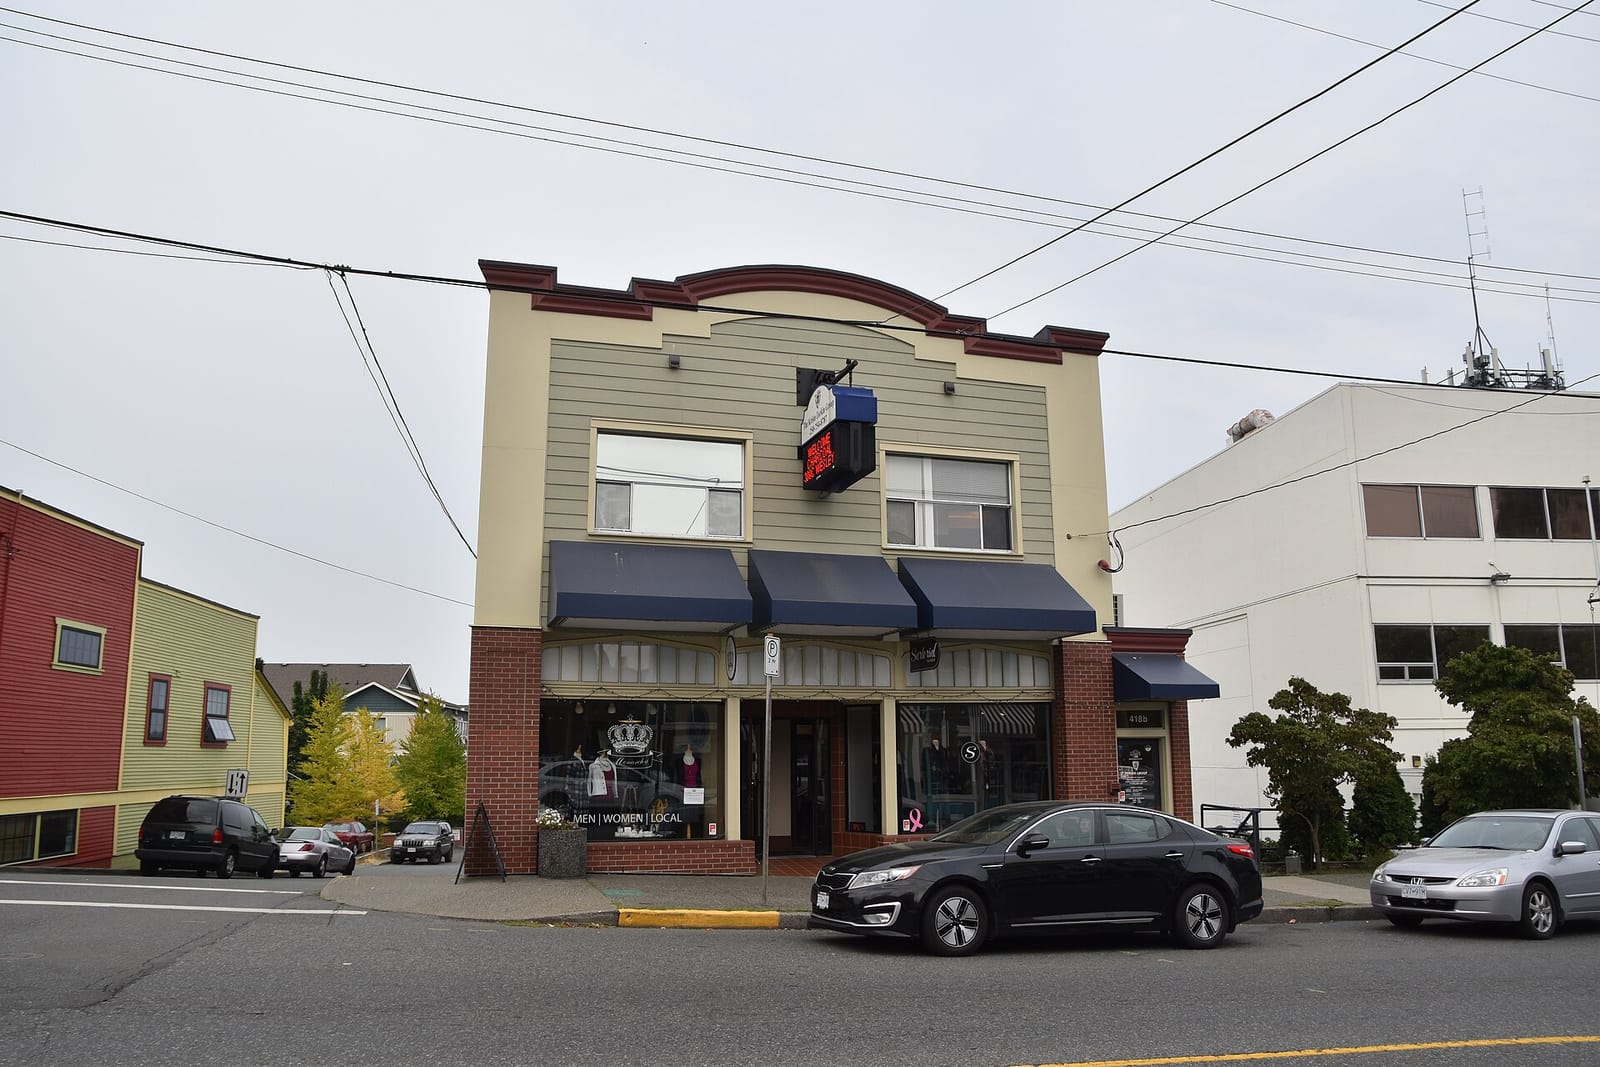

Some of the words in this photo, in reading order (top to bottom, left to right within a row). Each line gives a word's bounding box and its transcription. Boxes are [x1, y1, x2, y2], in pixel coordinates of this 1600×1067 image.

[1129, 714, 1148, 723] 418b
[964, 745, 977, 759] S
[573, 814, 596, 824] MEN
[603, 814, 643, 824] WOMEN
[651, 813, 682, 823] LOCAL
